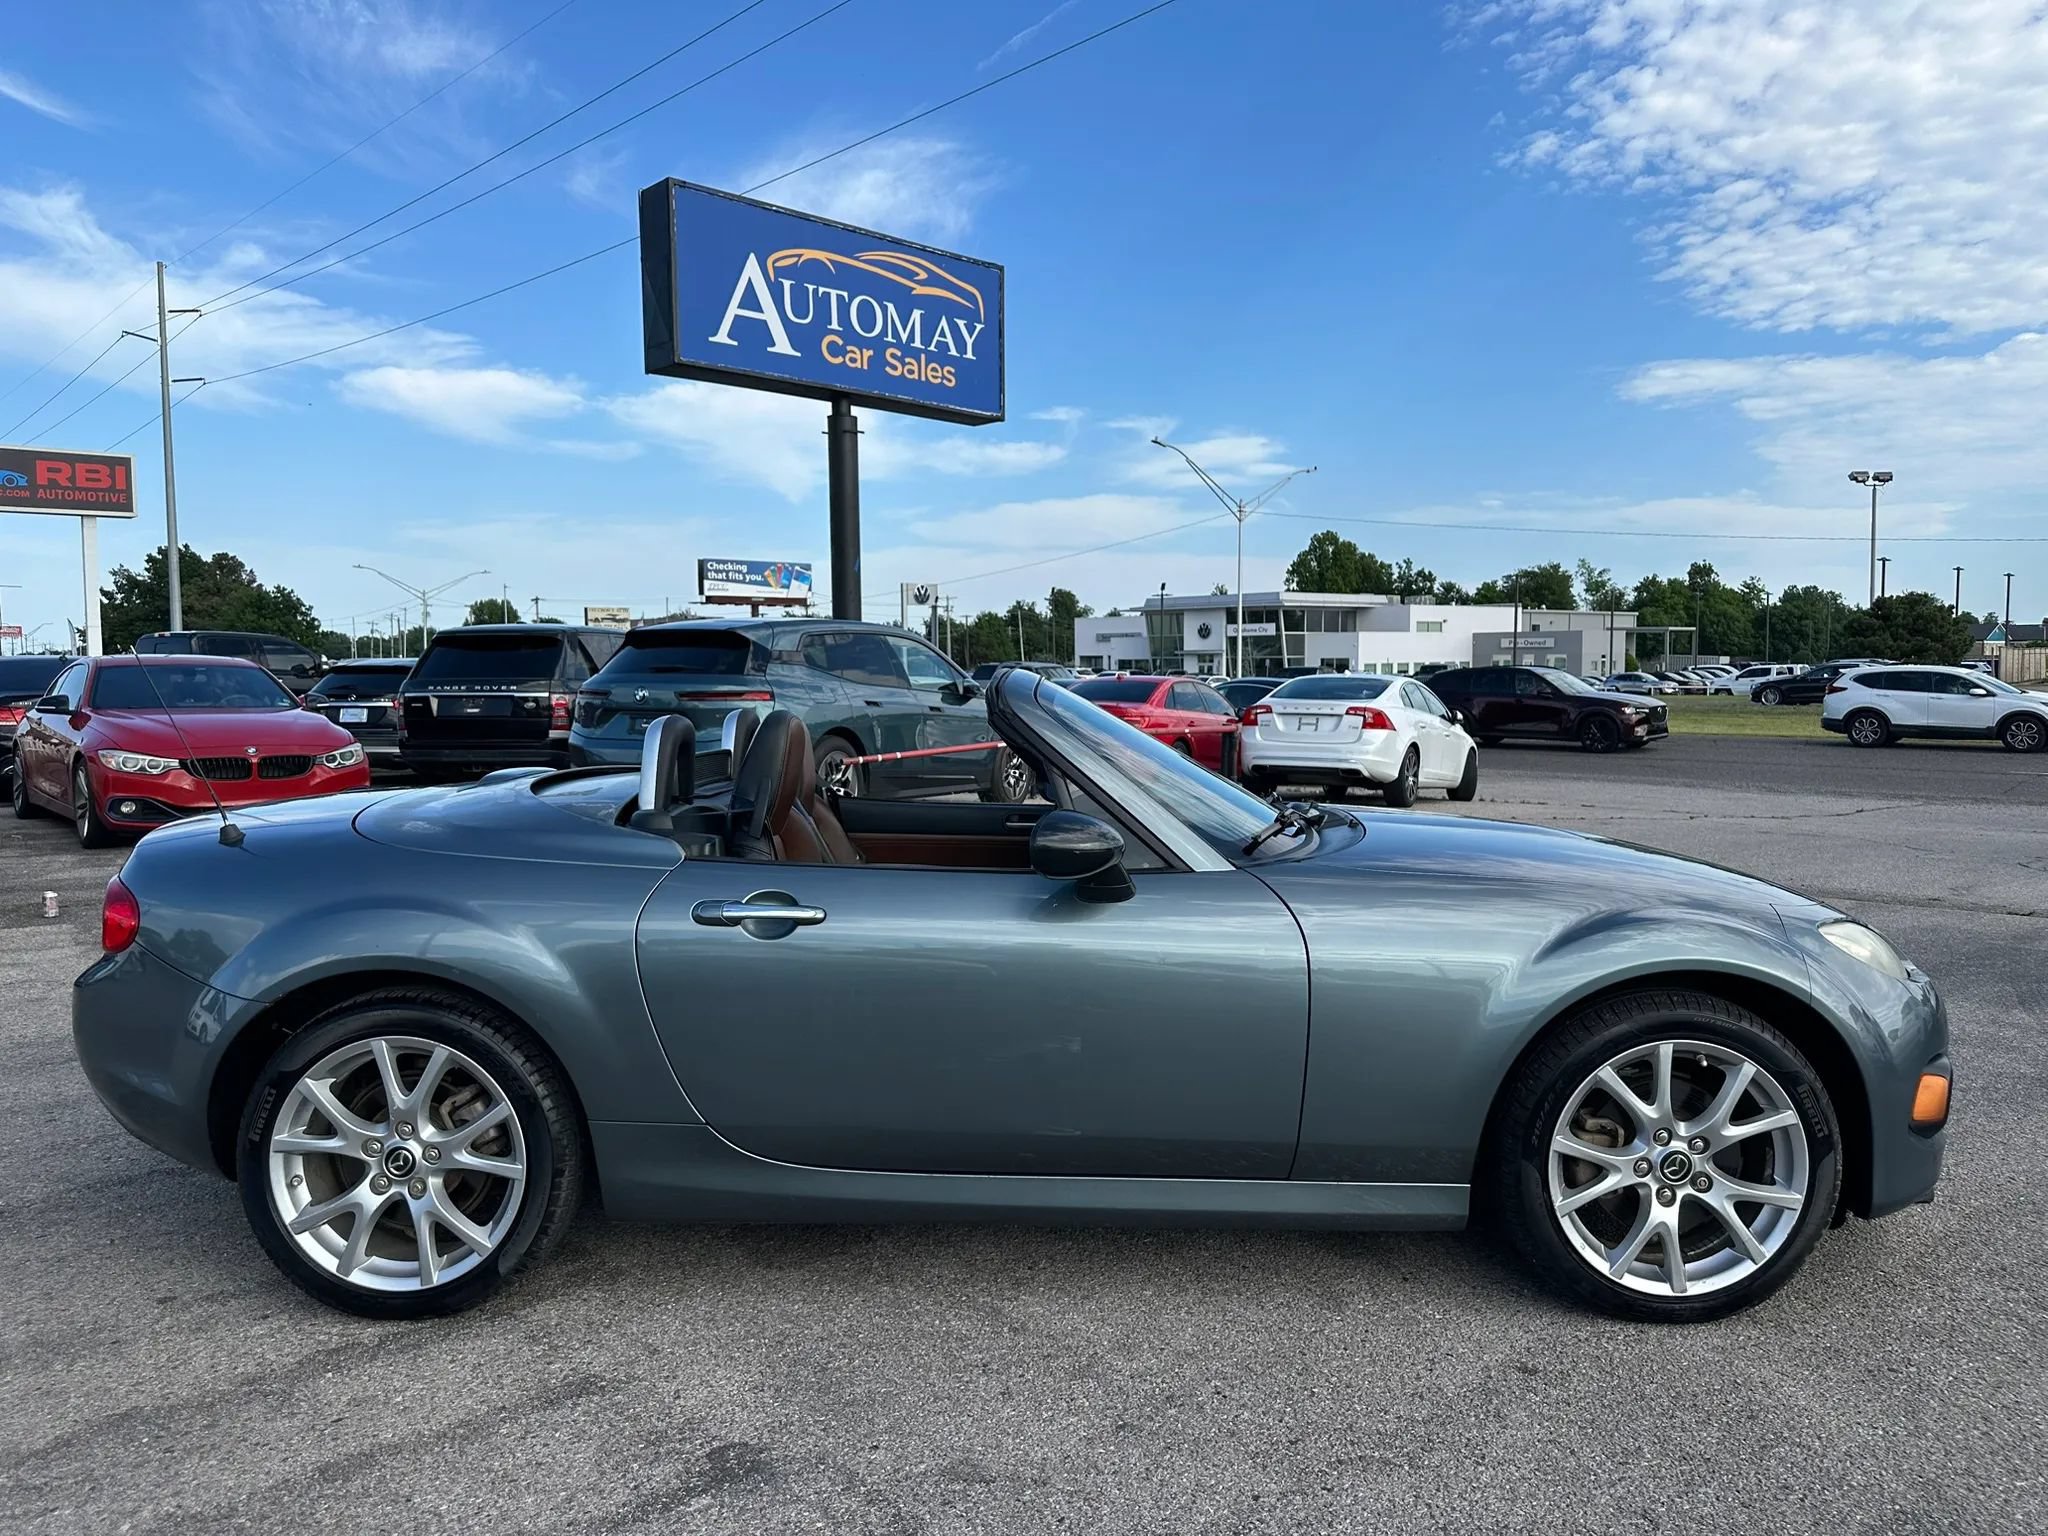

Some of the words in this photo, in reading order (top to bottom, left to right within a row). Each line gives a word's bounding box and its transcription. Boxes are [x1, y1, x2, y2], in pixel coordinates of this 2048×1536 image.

[708, 252, 985, 360] AUTOMAY
[820, 334, 873, 370] Car
[885, 346, 957, 388] Sales
[0, 488, 30, 498] .COM
[37, 488, 128, 503] AUTOMOTIVE
[36, 460, 127, 490] RBI
[707, 561, 748, 573] Checking
[707, 571, 727, 580] that
[729, 571, 744, 581] fits
[745, 573, 765, 583] you.
[247, 1085, 277, 1142] PIRELLI
[1796, 1083, 1828, 1138] PIRELLI
